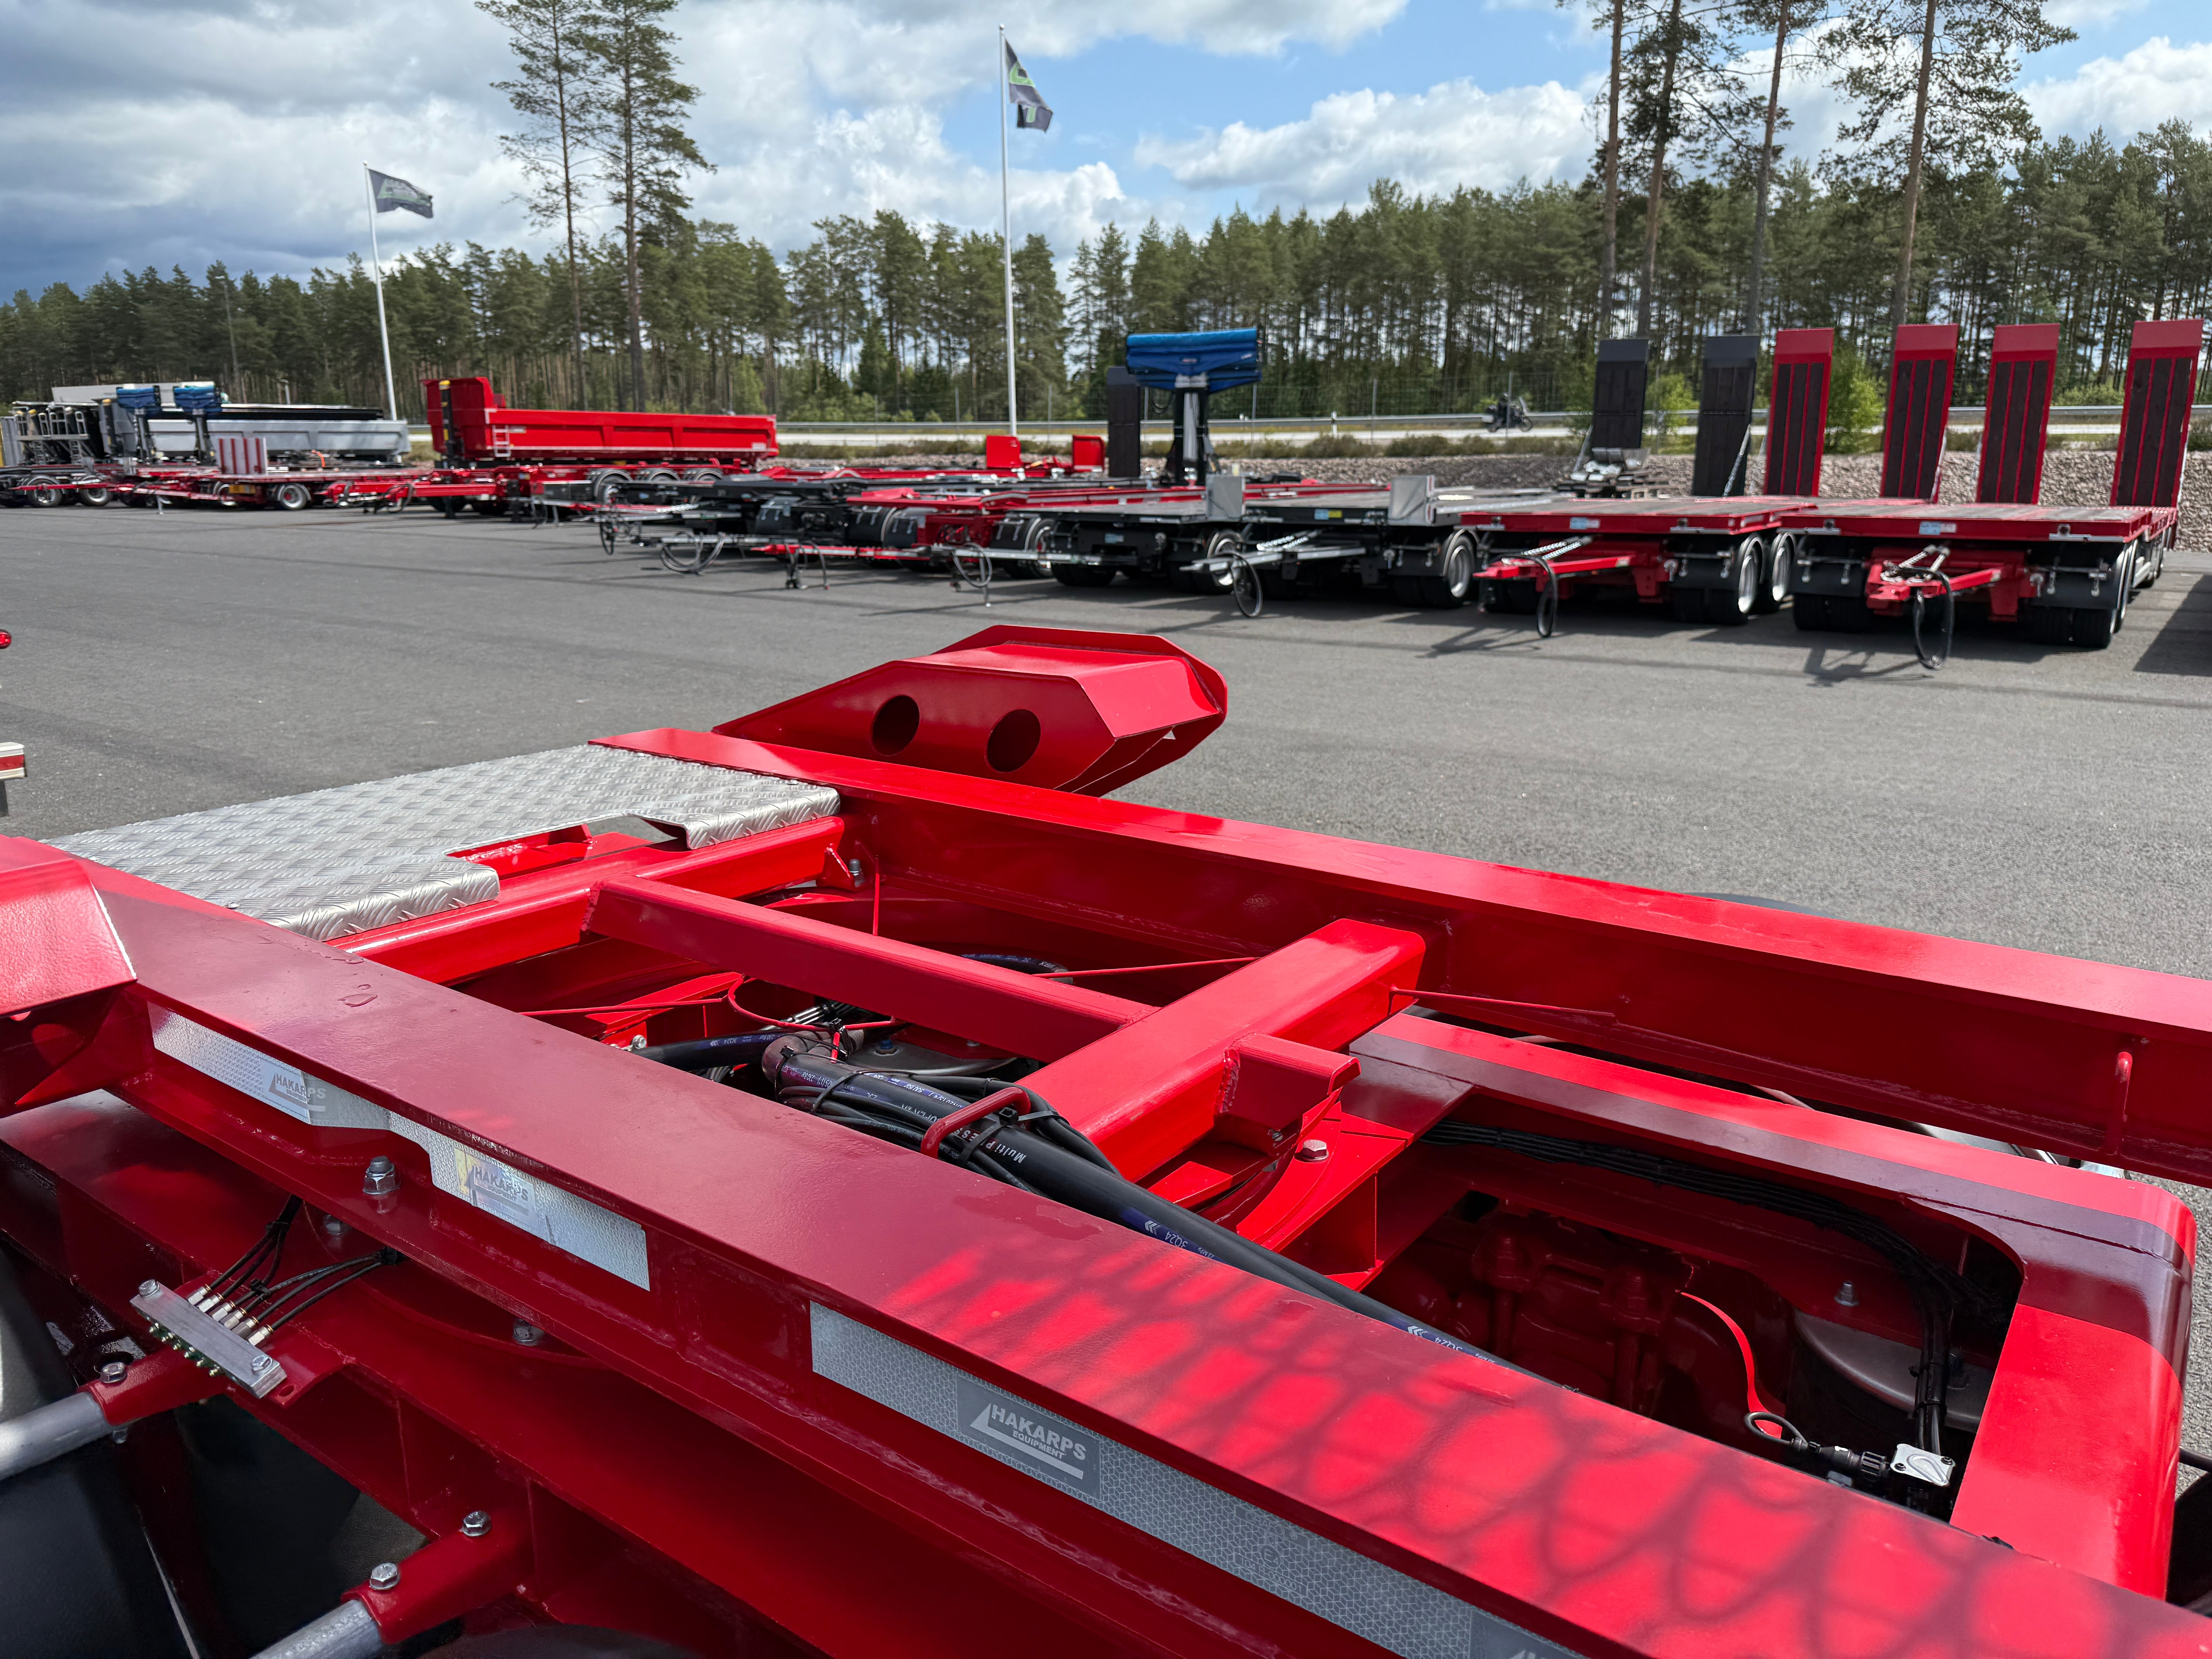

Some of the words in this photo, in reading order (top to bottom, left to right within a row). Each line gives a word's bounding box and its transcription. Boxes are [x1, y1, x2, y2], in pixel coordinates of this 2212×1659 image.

[276, 1073, 326, 1099] HAKARPS
[994, 1144, 1027, 1164] Multi
[475, 1166, 529, 1201] HAKARPS
[1164, 1231, 1188, 1248] 3Q24
[991, 1404, 1086, 1460] HAKARPS
[1013, 1430, 1066, 1459] EQUIPMENT
